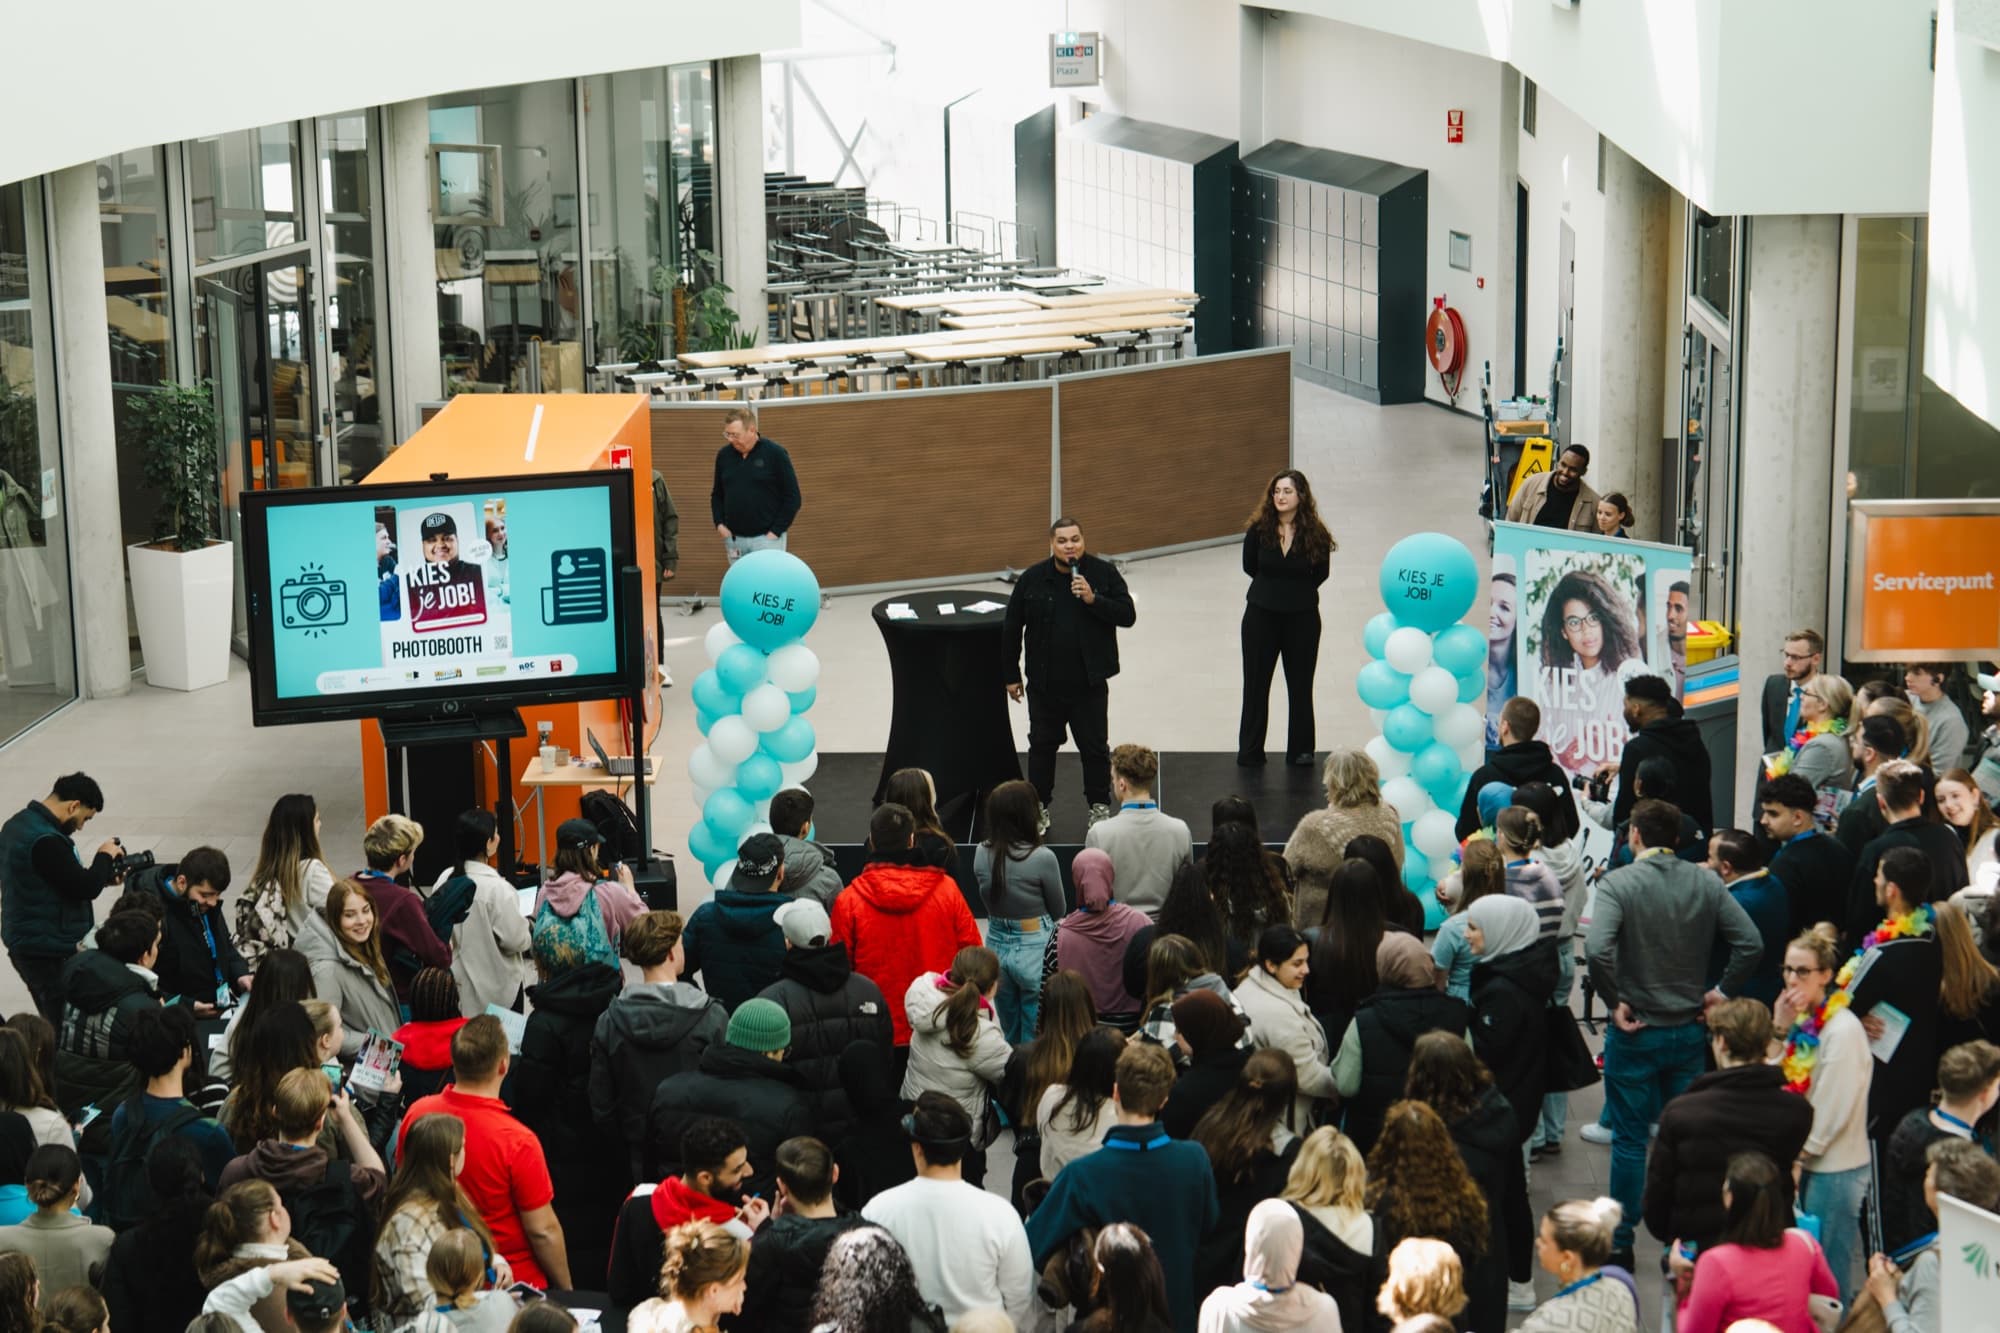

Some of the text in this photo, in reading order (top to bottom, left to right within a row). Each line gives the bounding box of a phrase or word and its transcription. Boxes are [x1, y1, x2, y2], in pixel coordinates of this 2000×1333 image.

[1056, 67, 1079, 75] Plaza
[408, 560, 451, 588] KIES
[1399, 568, 1445, 587] KIES JE
[1872, 571, 1995, 596] Servicepunt
[412, 588, 436, 622] je
[438, 581, 477, 611] JOB!
[752, 592, 795, 611] KIES JE
[1404, 586, 1432, 600] JOB!
[757, 611, 785, 626] JOB!
[392, 635, 483, 660] PHOTOBOOTH
[518, 660, 535, 671] ROC
[1535, 665, 1597, 712] KIES
